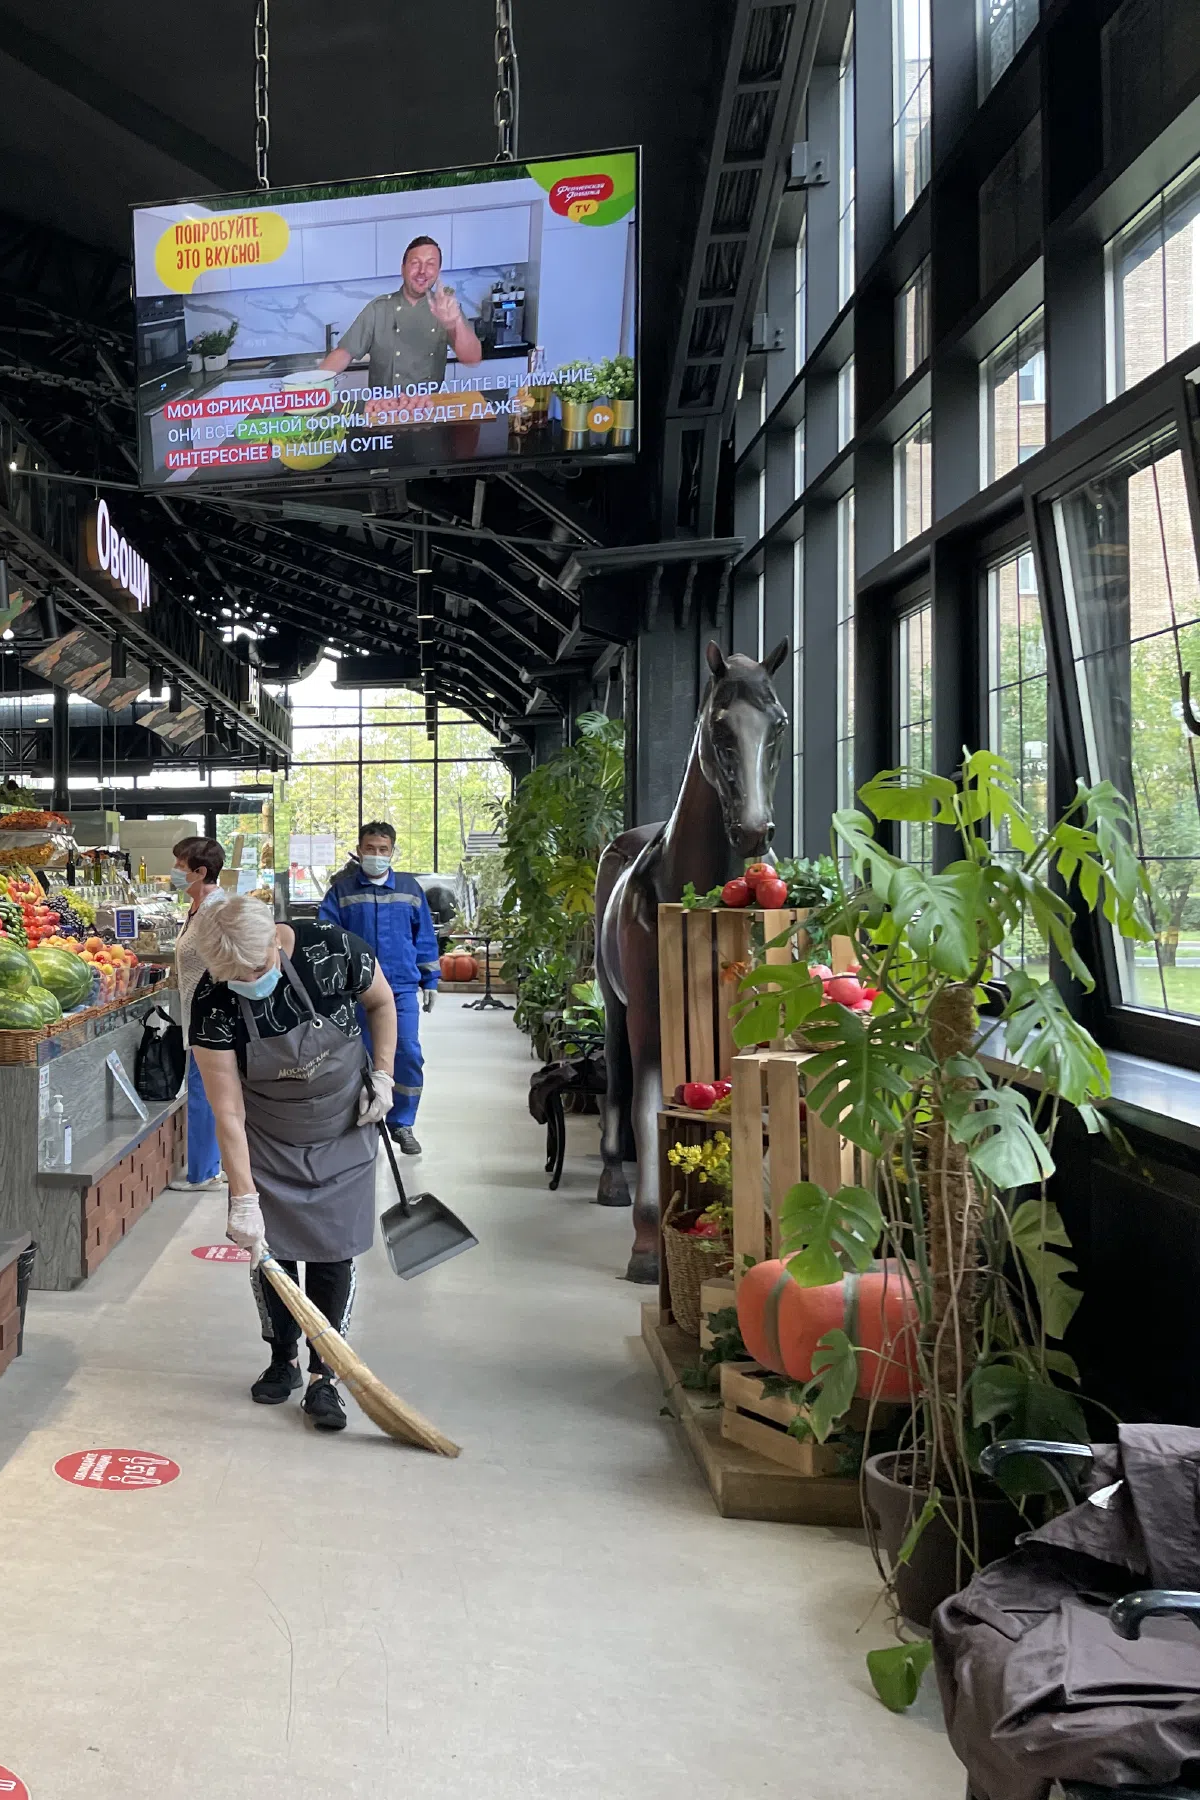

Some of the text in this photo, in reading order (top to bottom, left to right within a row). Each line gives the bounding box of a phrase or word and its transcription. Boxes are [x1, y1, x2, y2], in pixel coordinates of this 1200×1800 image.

[575, 204, 590, 213] TV
[175, 216, 263, 245] ПОПРОБУЙТЕ,
[176, 241, 260, 270] ЭТО ВКУСНО!
[167, 367, 597, 419] МОИ ФРИКАДЕЛЬКИ ГОТОВЫ! ОБРАТИТЕ ВНИМАНИЕ,
[168, 400, 522, 443] ОНИ ВСЕ РАЗНОЙ ФОРМЫ, ЭТО БУДЕТ ДАЖЕ
[593, 412, 610, 425] 0+
[168, 435, 394, 467] ИНТЕРЕСНЕЕ В НАШЕМ СУПЕ
